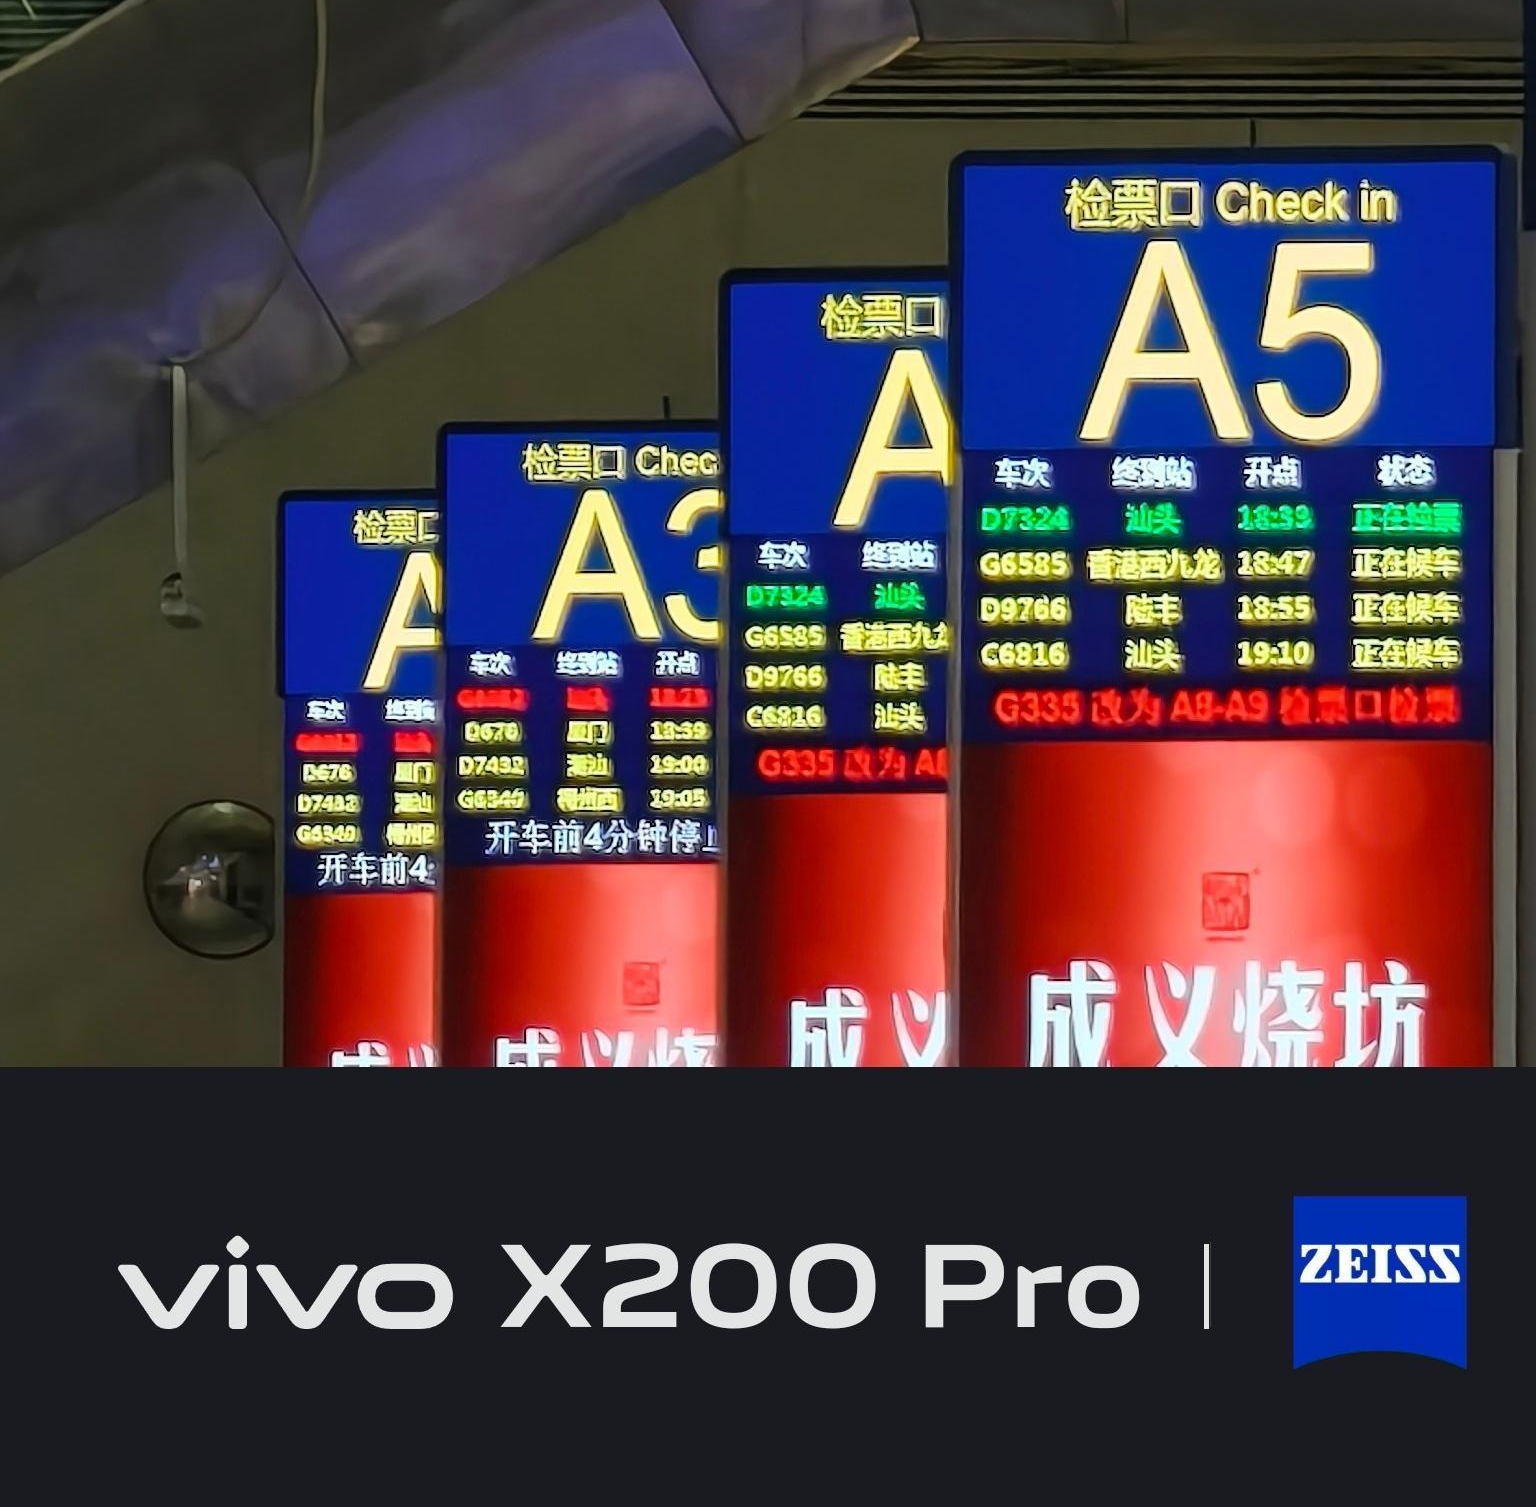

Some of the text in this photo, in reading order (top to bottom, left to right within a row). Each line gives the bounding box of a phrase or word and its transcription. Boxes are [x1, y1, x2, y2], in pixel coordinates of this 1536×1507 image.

[1065, 178, 1397, 231] 检票口 Check in
[821, 294, 944, 341] 检票口
[1080, 238, 1381, 445] A5
[522, 443, 626, 481] 检票口
[995, 458, 1050, 489] 车次
[1244, 456, 1301, 488] 开点
[1378, 454, 1435, 489] 状态
[532, 489, 724, 642] A3
[1238, 641, 1314, 669] 19:10
[318, 852, 435, 886] 开车前4
